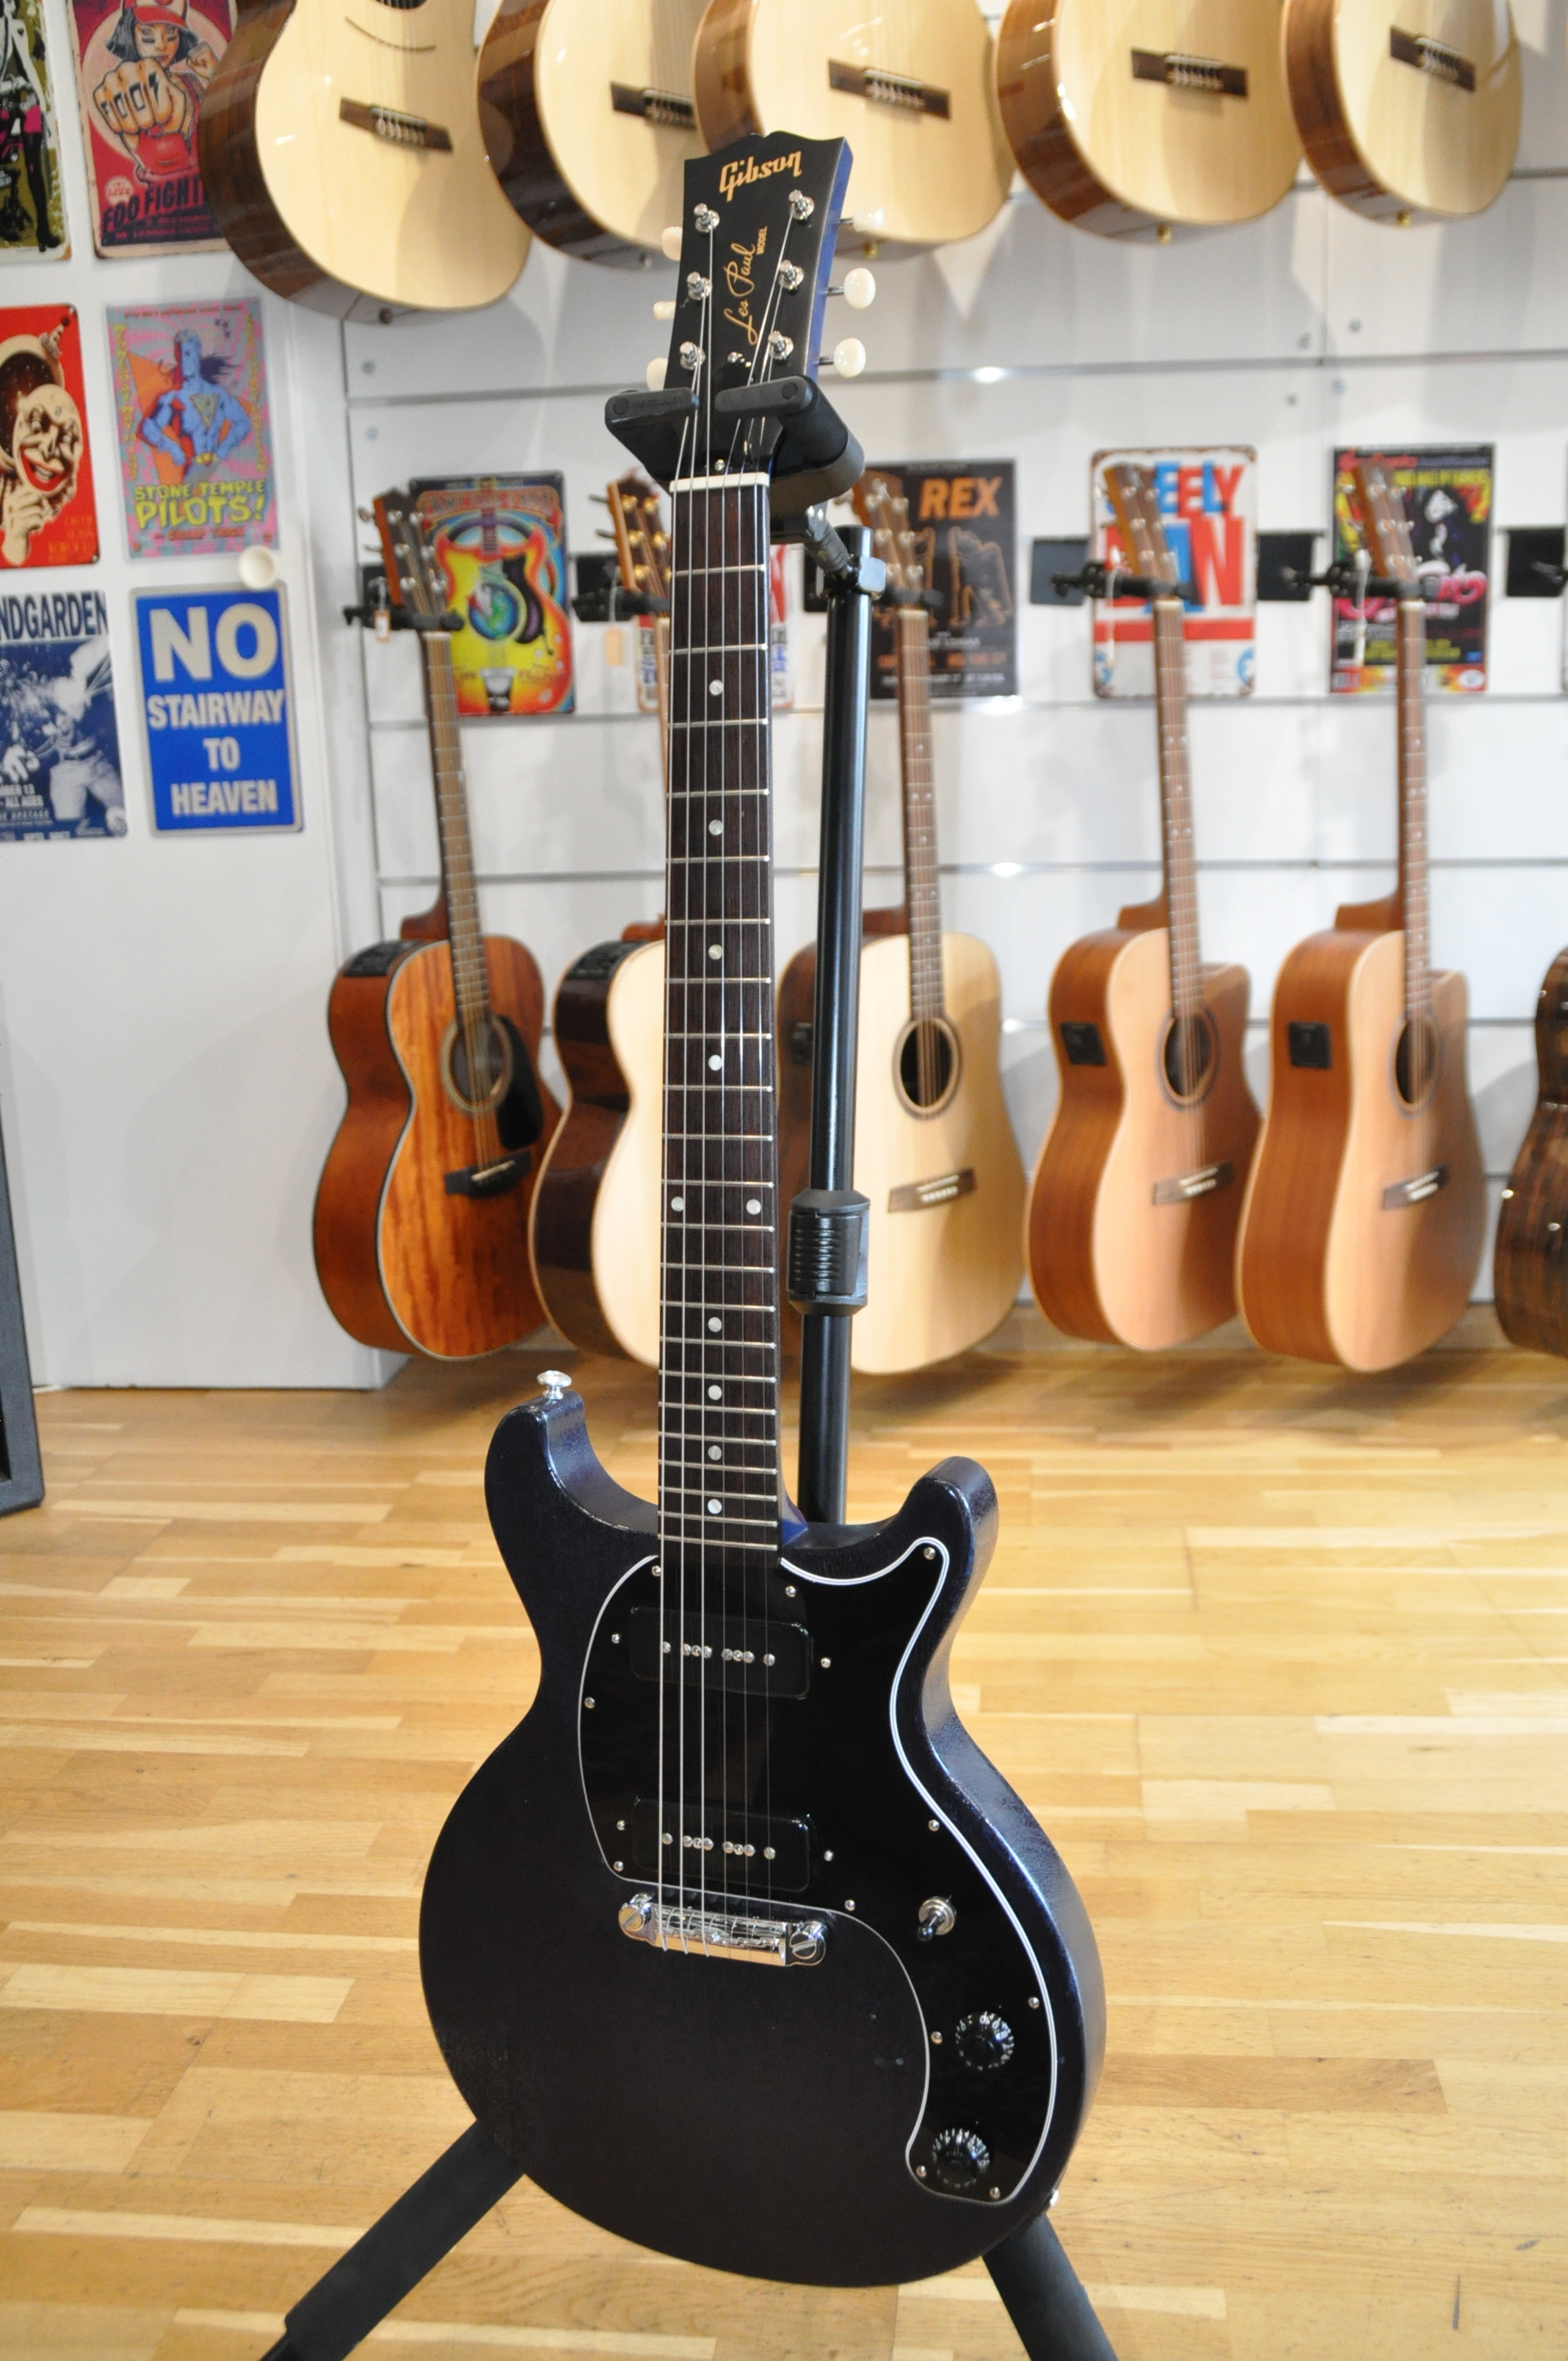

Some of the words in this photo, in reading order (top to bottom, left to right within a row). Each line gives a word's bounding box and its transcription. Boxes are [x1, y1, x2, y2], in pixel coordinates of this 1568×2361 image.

[719, 150, 802, 203] Gibson
[102, 195, 140, 233] FOO
[756, 225, 768, 255] MODEL
[723, 242, 756, 297] Paul
[724, 299, 758, 346] Les
[134, 483, 190, 501] STONE
[198, 479, 265, 497] TEMPLE
[920, 476, 1002, 520] REX
[135, 494, 265, 530] PILOTS!
[149, 603, 279, 682] NO
[148, 689, 285, 730] STAIRWAY
[203, 736, 241, 772] TO
[170, 779, 279, 818] HEAVEN
